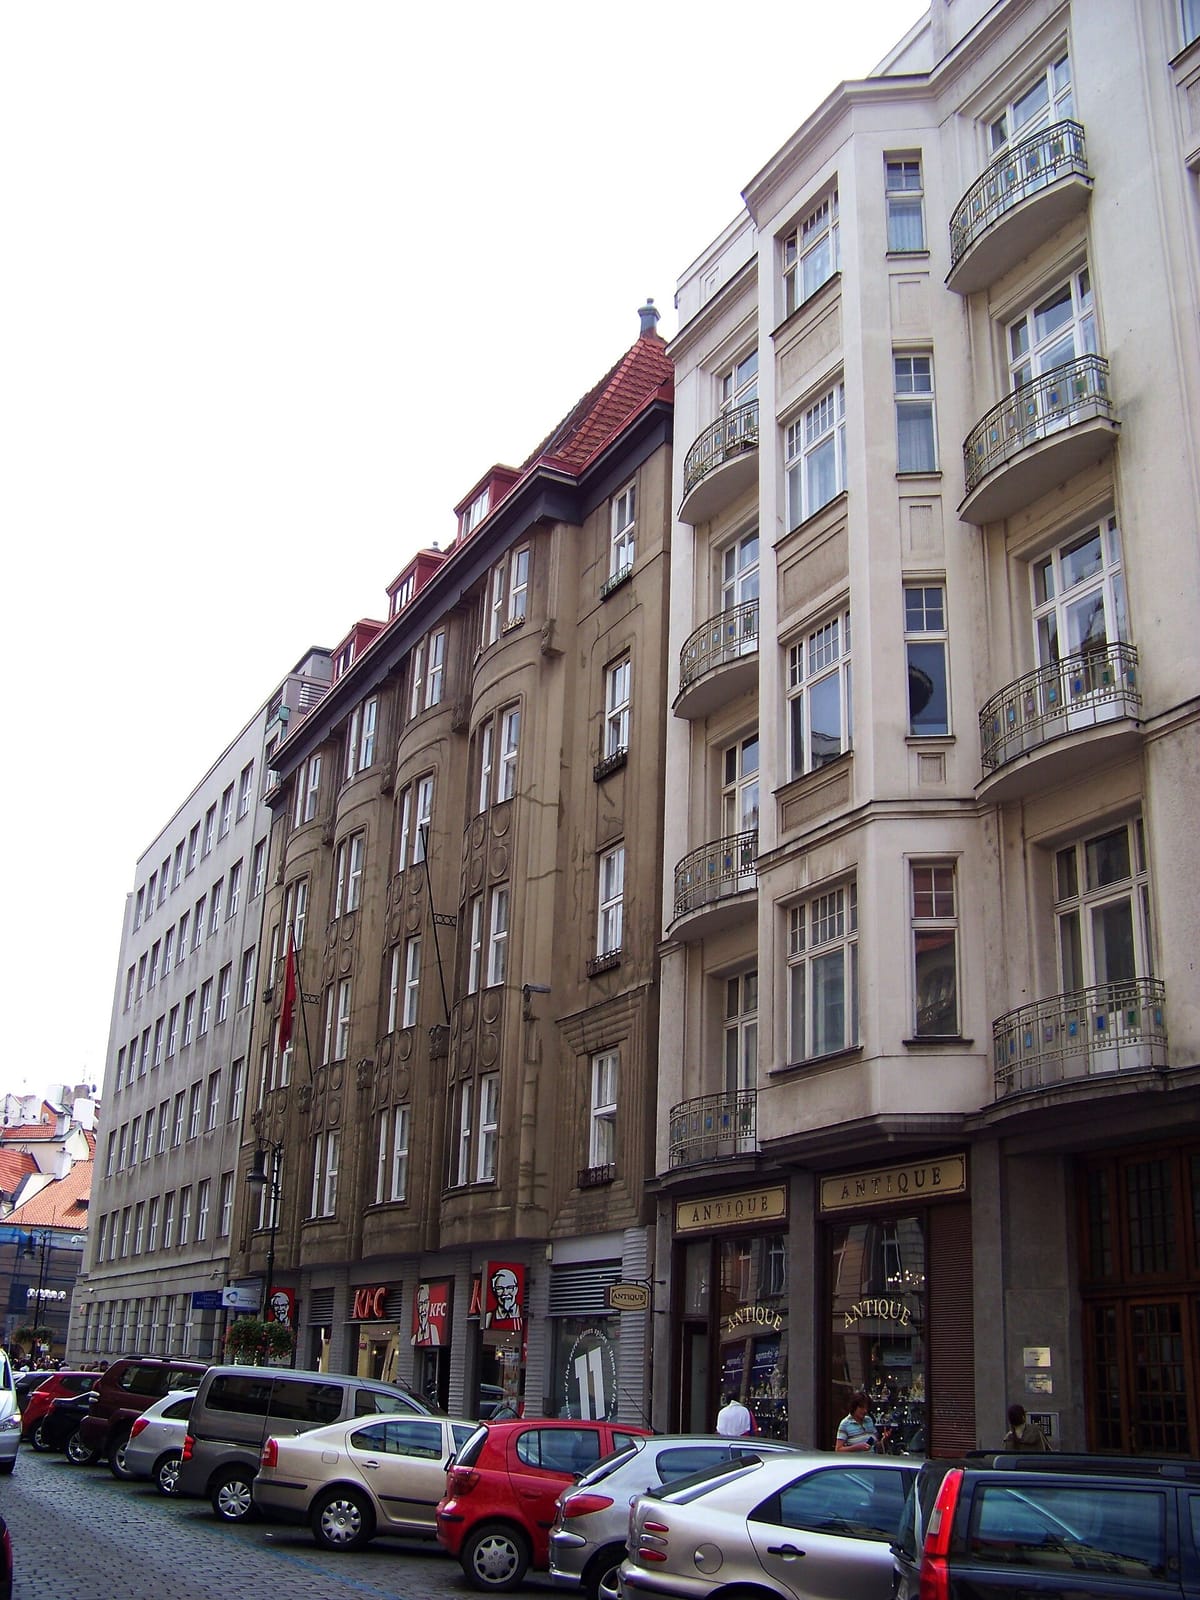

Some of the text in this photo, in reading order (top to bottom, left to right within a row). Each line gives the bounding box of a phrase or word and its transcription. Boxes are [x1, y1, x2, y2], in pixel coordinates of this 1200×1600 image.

[841, 1166, 942, 1200] ANTIQUE
[692, 1195, 768, 1222] ANTIQUE
[351, 1285, 387, 1319] KFC
[429, 1302, 447, 1317] KFC
[613, 1293, 644, 1302] ANTIQUE
[728, 1306, 783, 1333] ANTIQUE
[844, 1298, 911, 1328] ANTIQUE
[575, 1346, 606, 1420] 11
